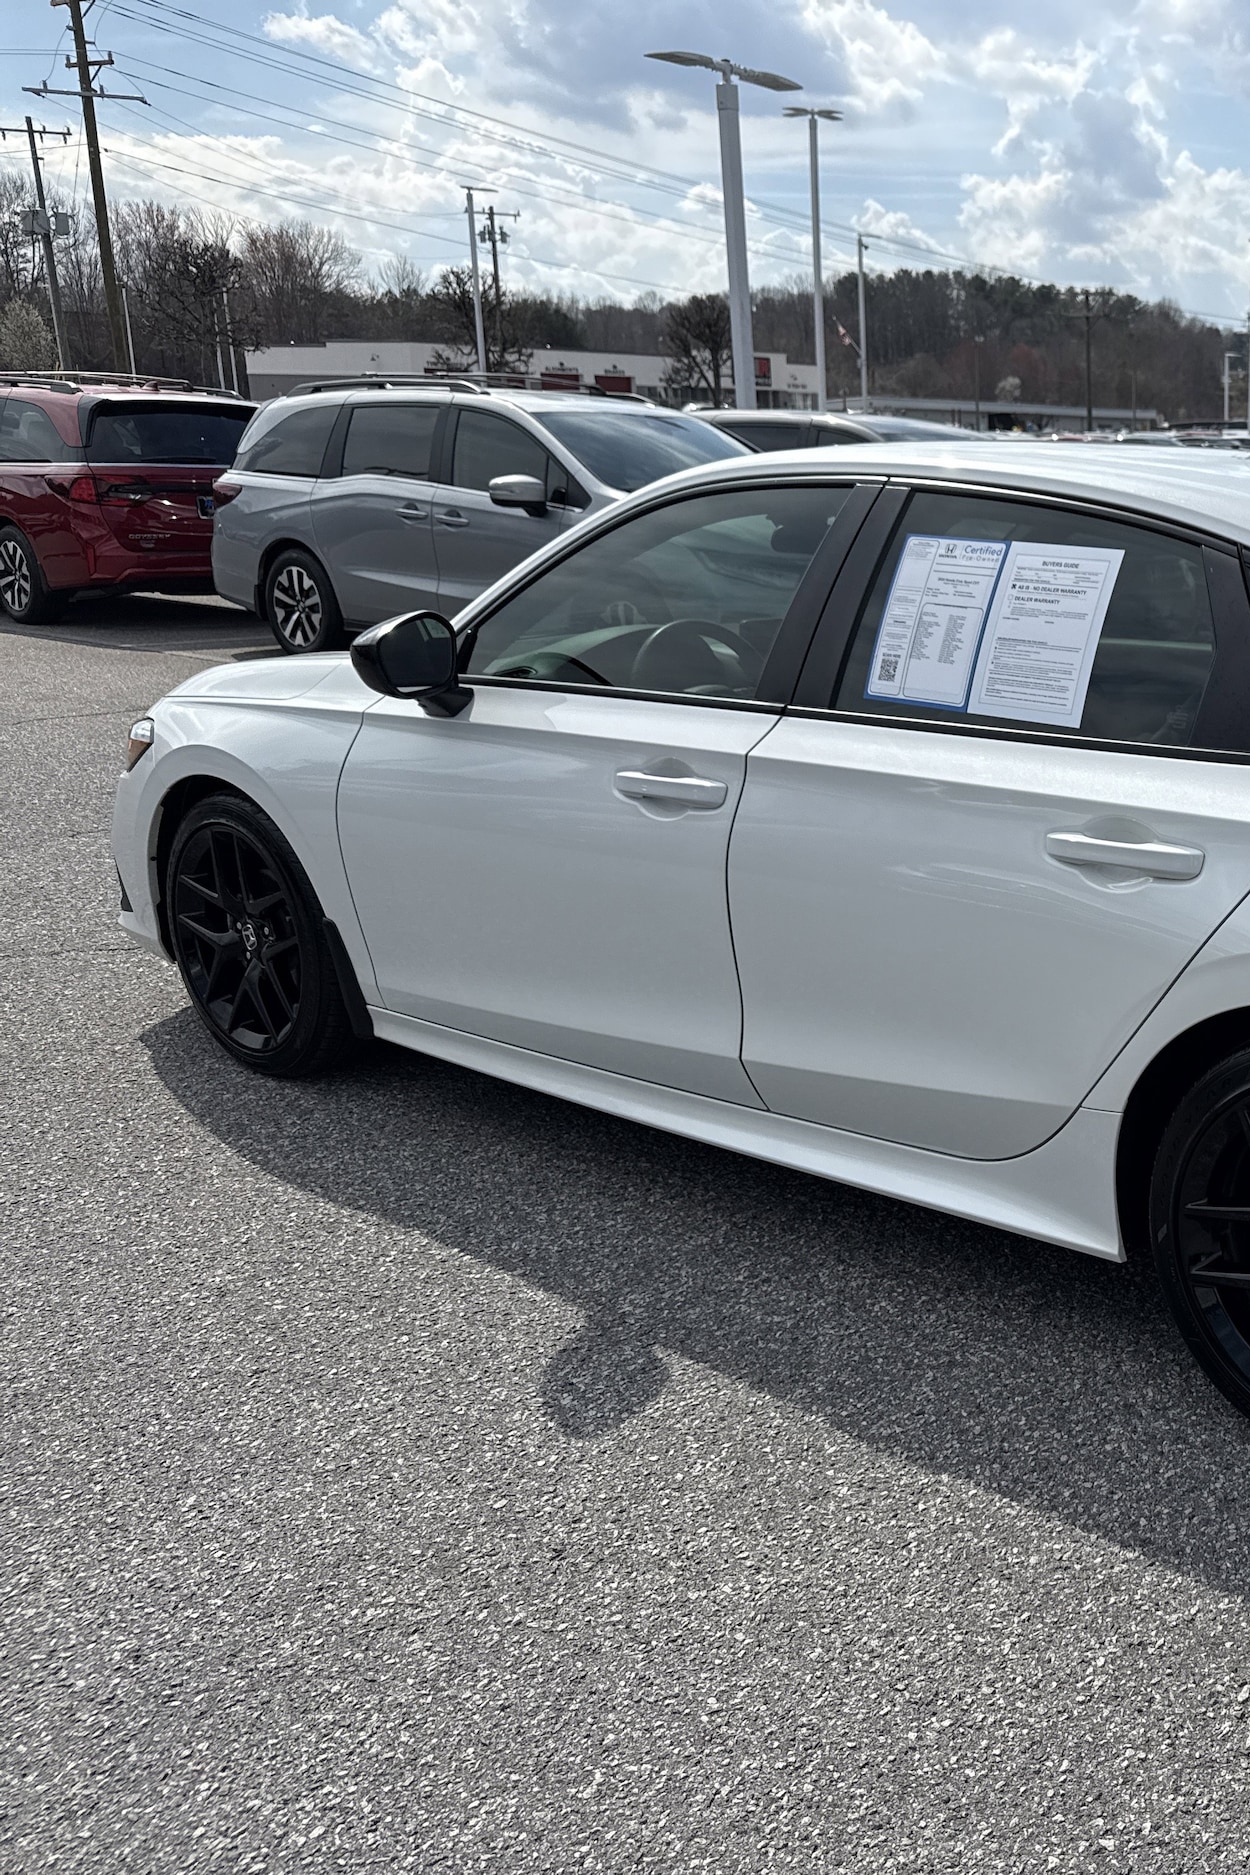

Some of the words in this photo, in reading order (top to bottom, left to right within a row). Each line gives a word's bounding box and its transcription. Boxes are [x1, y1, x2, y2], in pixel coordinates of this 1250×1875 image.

[964, 545, 1003, 557] Certified
[962, 554, 1000, 563] Pre-Owned
[1060, 588, 1087, 596] WARRANTY
[1014, 595, 1033, 603] DEALER
[1033, 597, 1060, 605] WARRANTY
